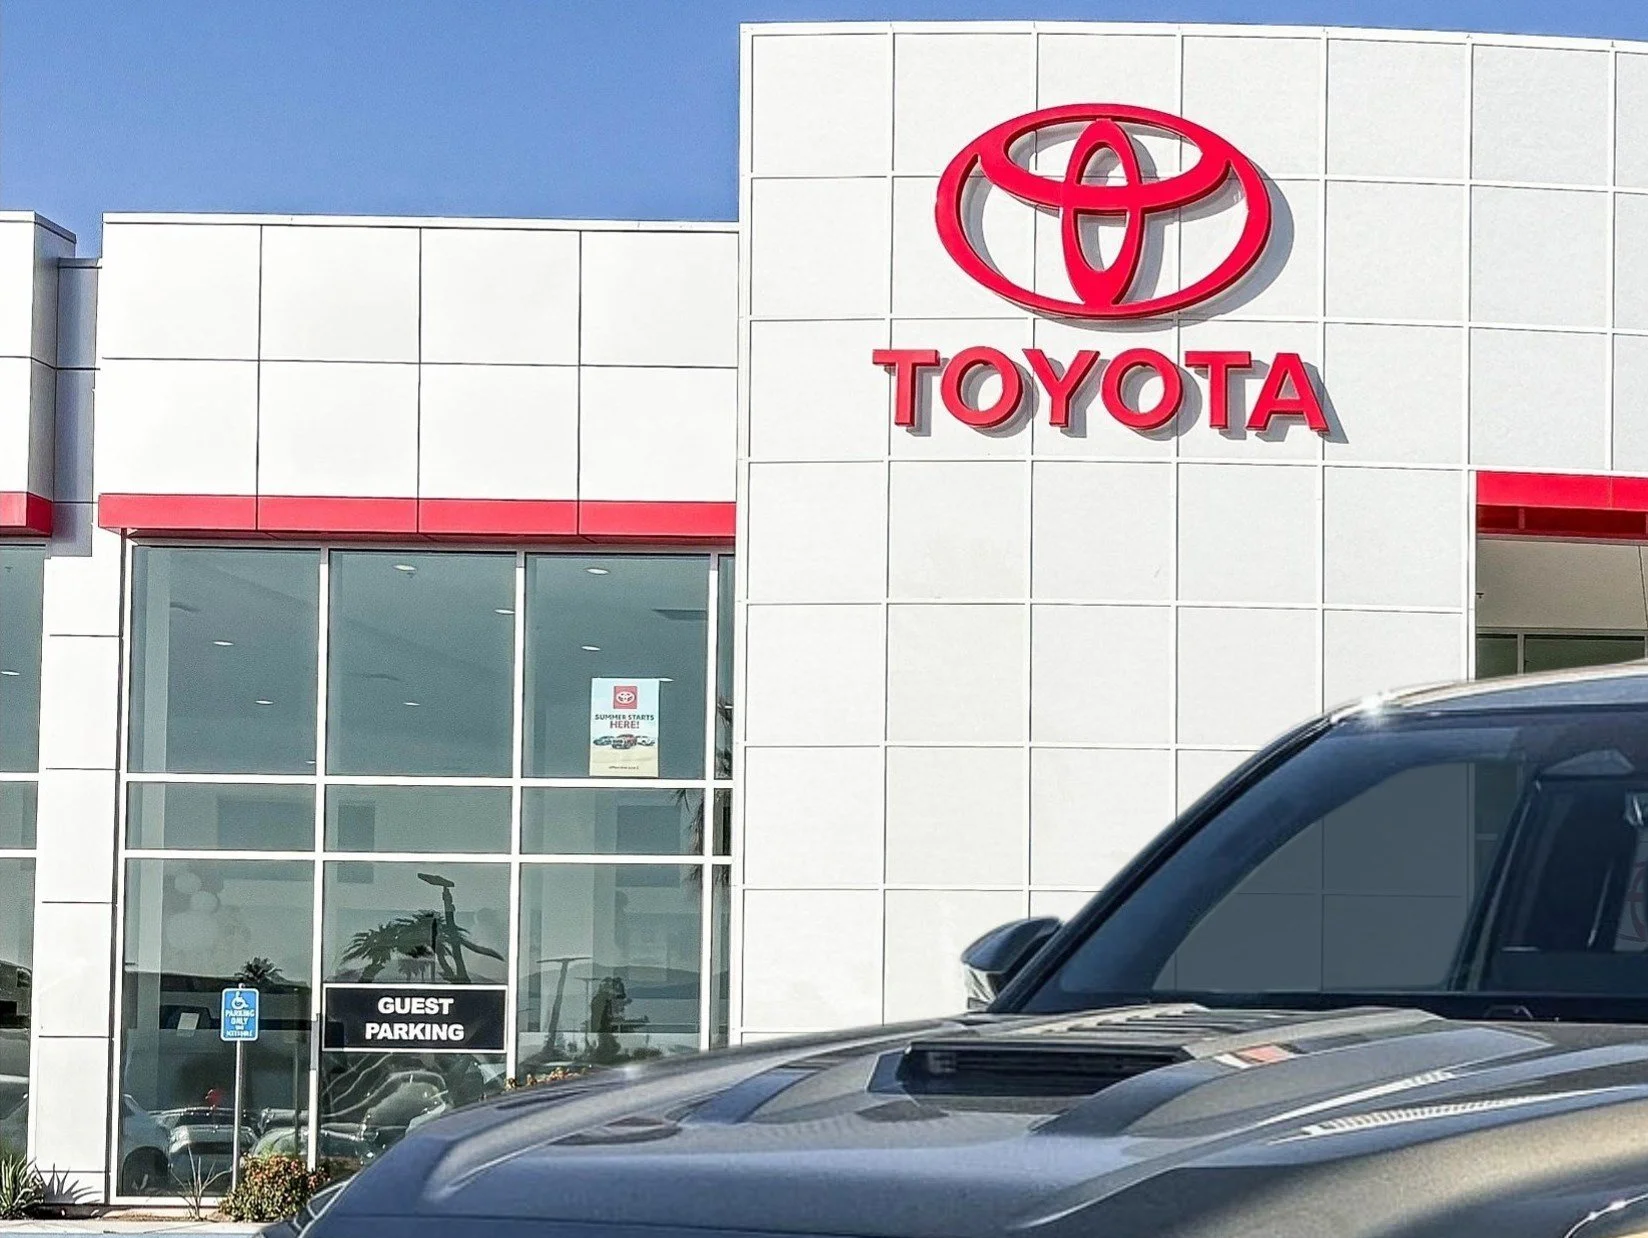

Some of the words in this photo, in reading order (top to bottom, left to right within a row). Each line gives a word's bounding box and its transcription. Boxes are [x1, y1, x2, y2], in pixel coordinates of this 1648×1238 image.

[873, 346, 1330, 434] TOYOTA
[609, 720, 640, 729] HERE!
[377, 997, 454, 1015] GUEST
[365, 1022, 465, 1041] PARKING
